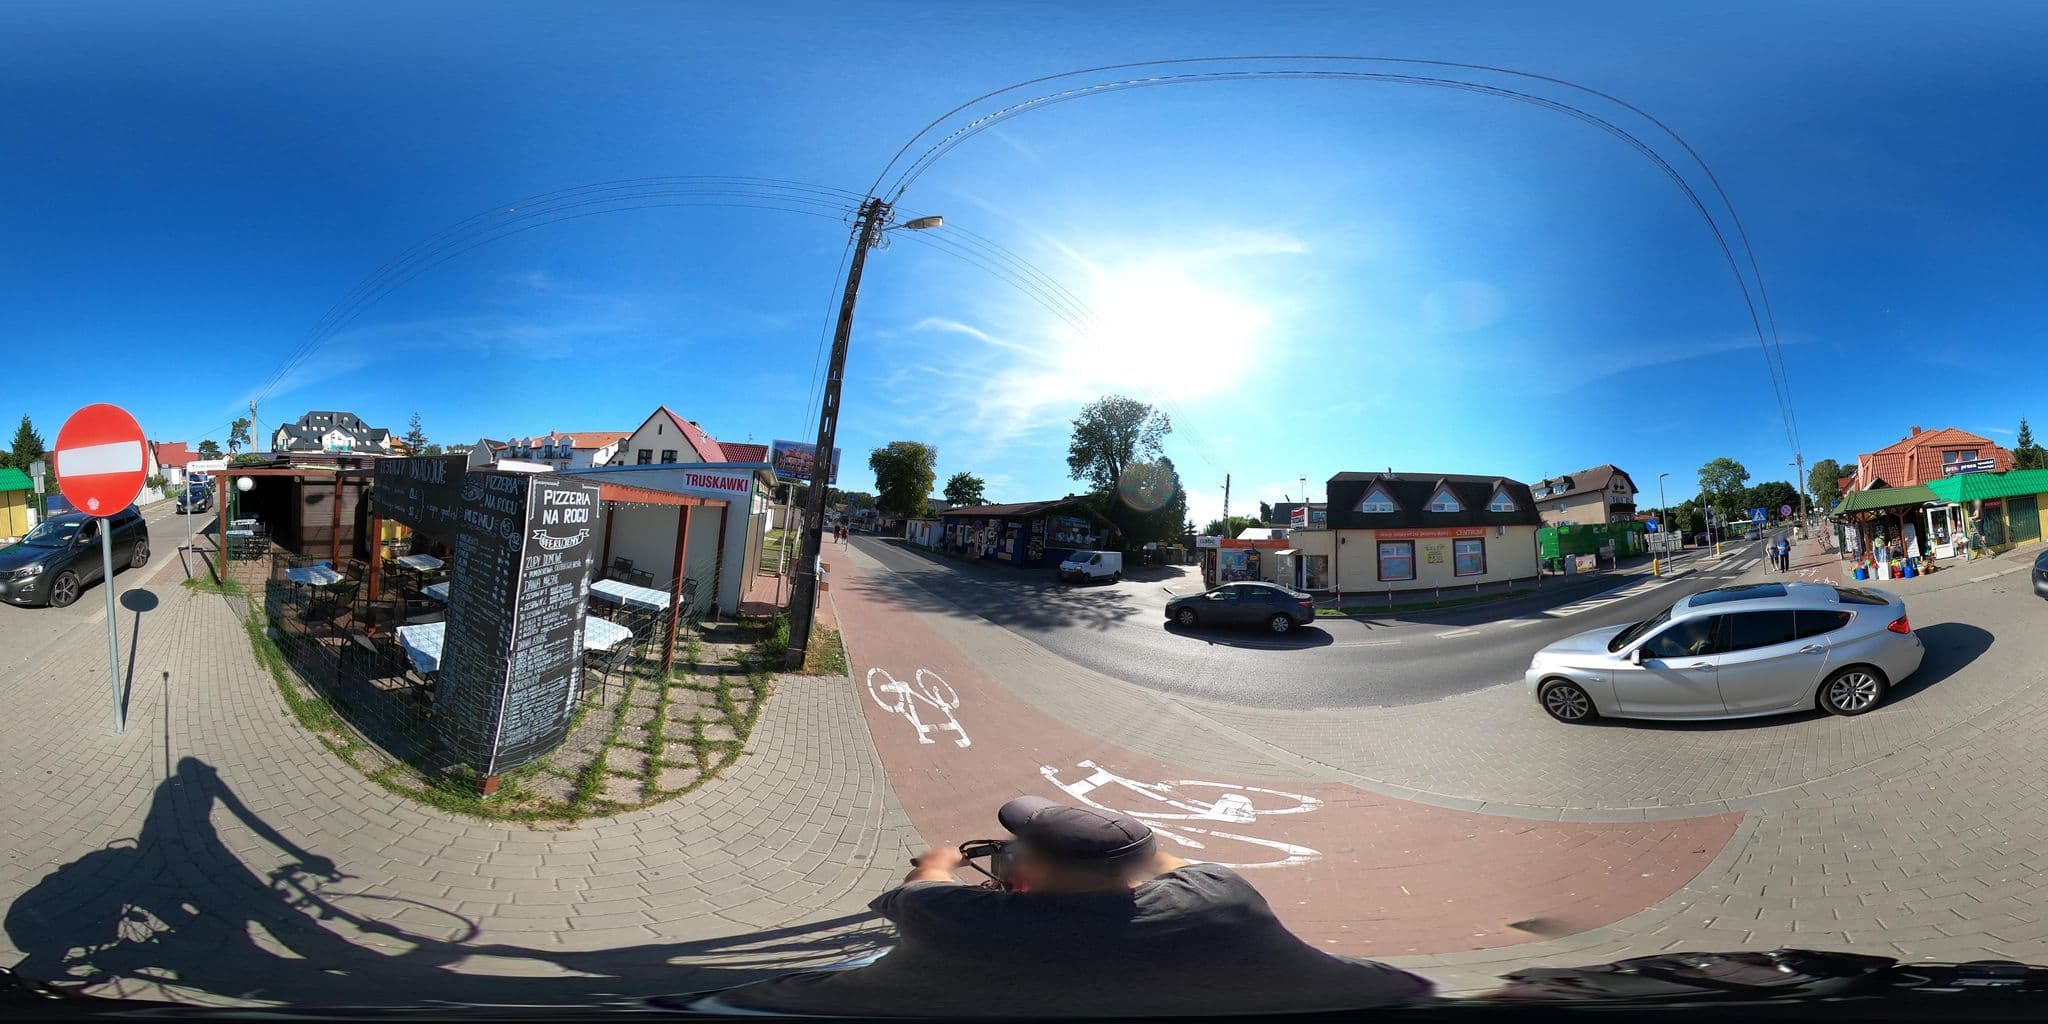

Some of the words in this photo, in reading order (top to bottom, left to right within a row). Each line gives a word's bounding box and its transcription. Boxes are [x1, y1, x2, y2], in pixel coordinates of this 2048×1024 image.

[485, 474, 519, 496] PIZZERIA
[685, 474, 749, 492] TRUSKAWKI
[484, 493, 497, 509] NA
[498, 496, 518, 515] ROGU
[543, 489, 591, 506] PIZZERIA
[464, 509, 494, 531] MENU
[542, 509, 559, 525] NA
[563, 508, 589, 524] ROGU
